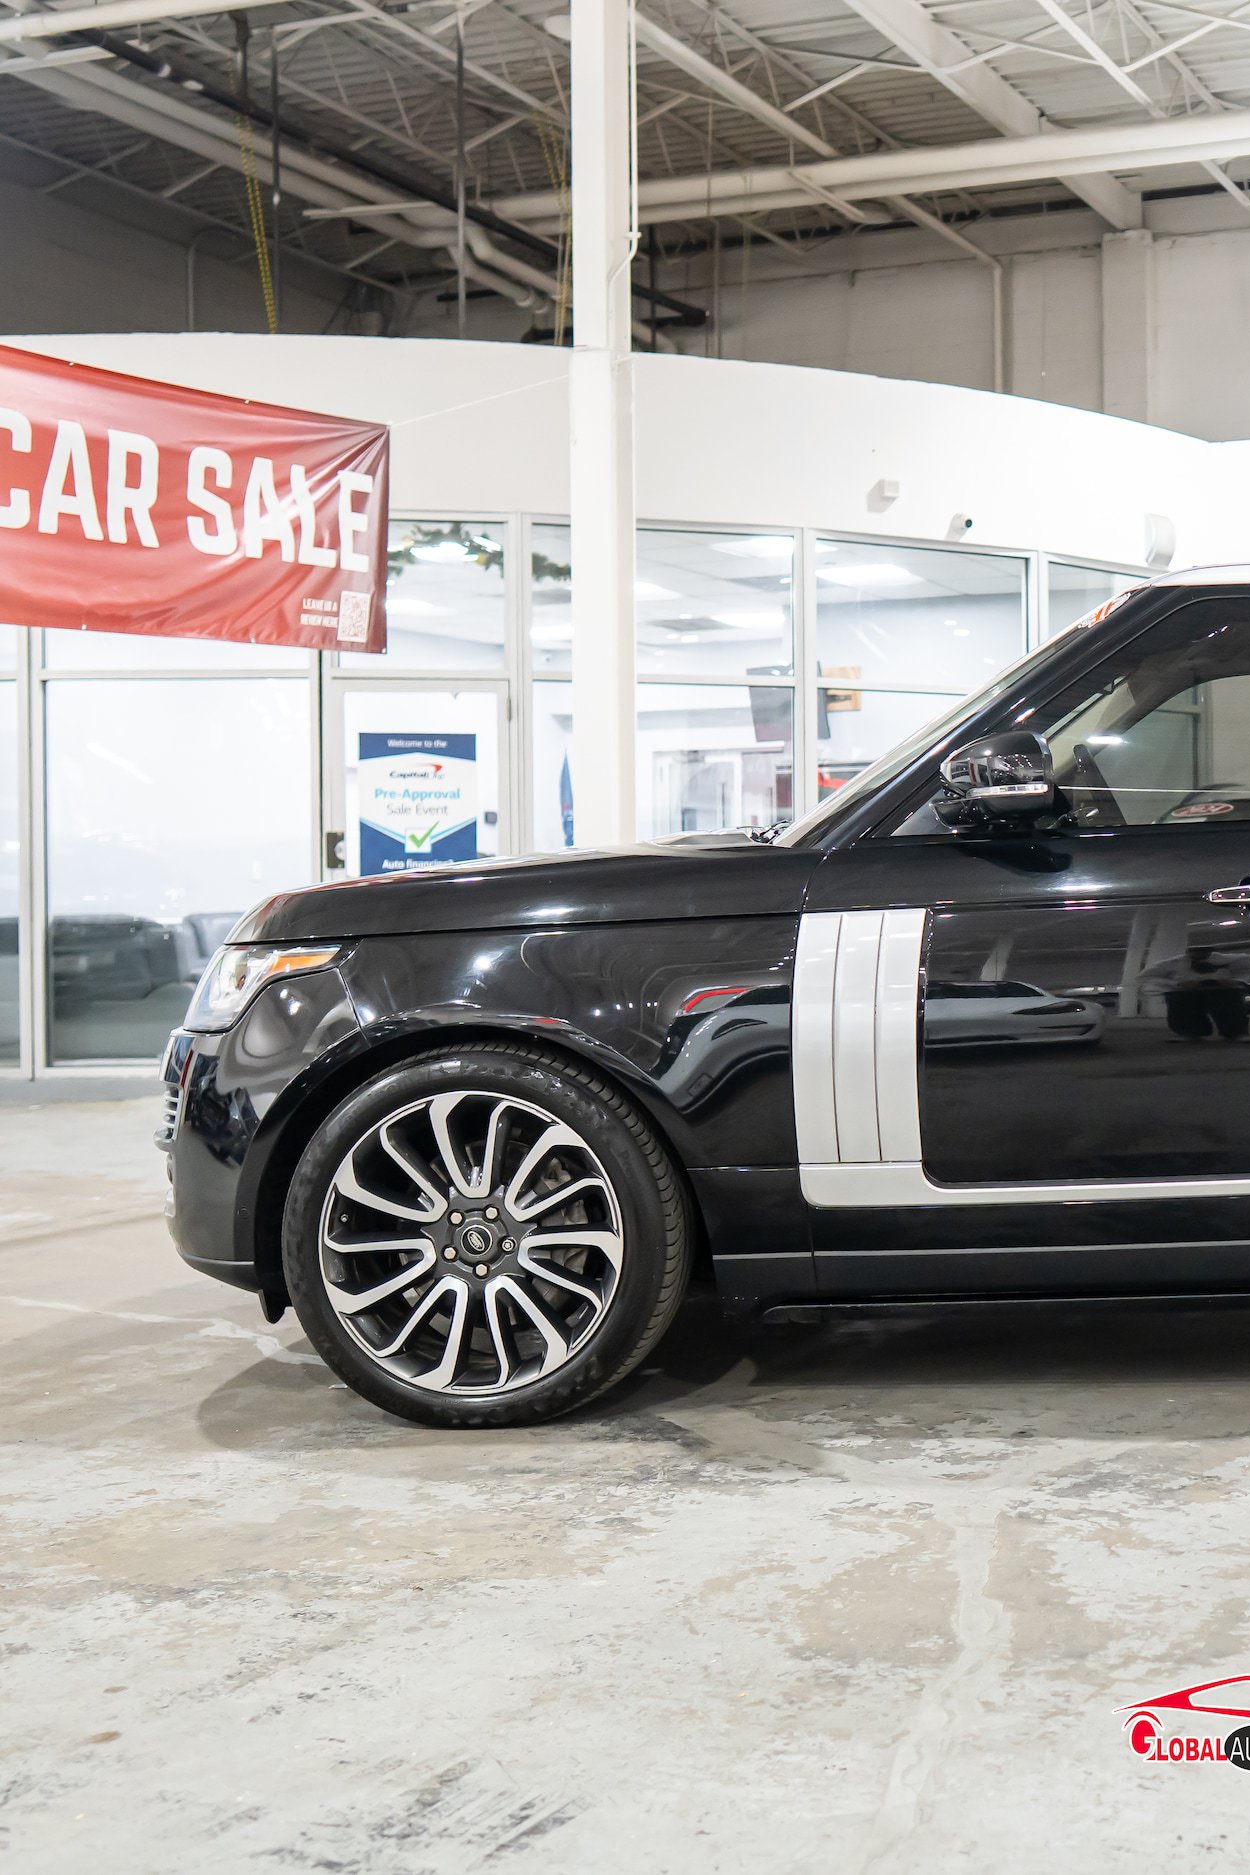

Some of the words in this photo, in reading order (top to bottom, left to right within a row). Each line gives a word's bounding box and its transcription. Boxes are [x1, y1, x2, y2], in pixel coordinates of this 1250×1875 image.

[0, 407, 160, 549] CAR
[186, 445, 374, 573] SALE
[387, 738, 422, 748] Welcome
[424, 740, 432, 748] to
[434, 739, 447, 748] the
[374, 788, 461, 801] Pre-Approval
[386, 803, 411, 815] Sale
[415, 804, 448, 815] Event
[382, 859, 405, 869] Auto
